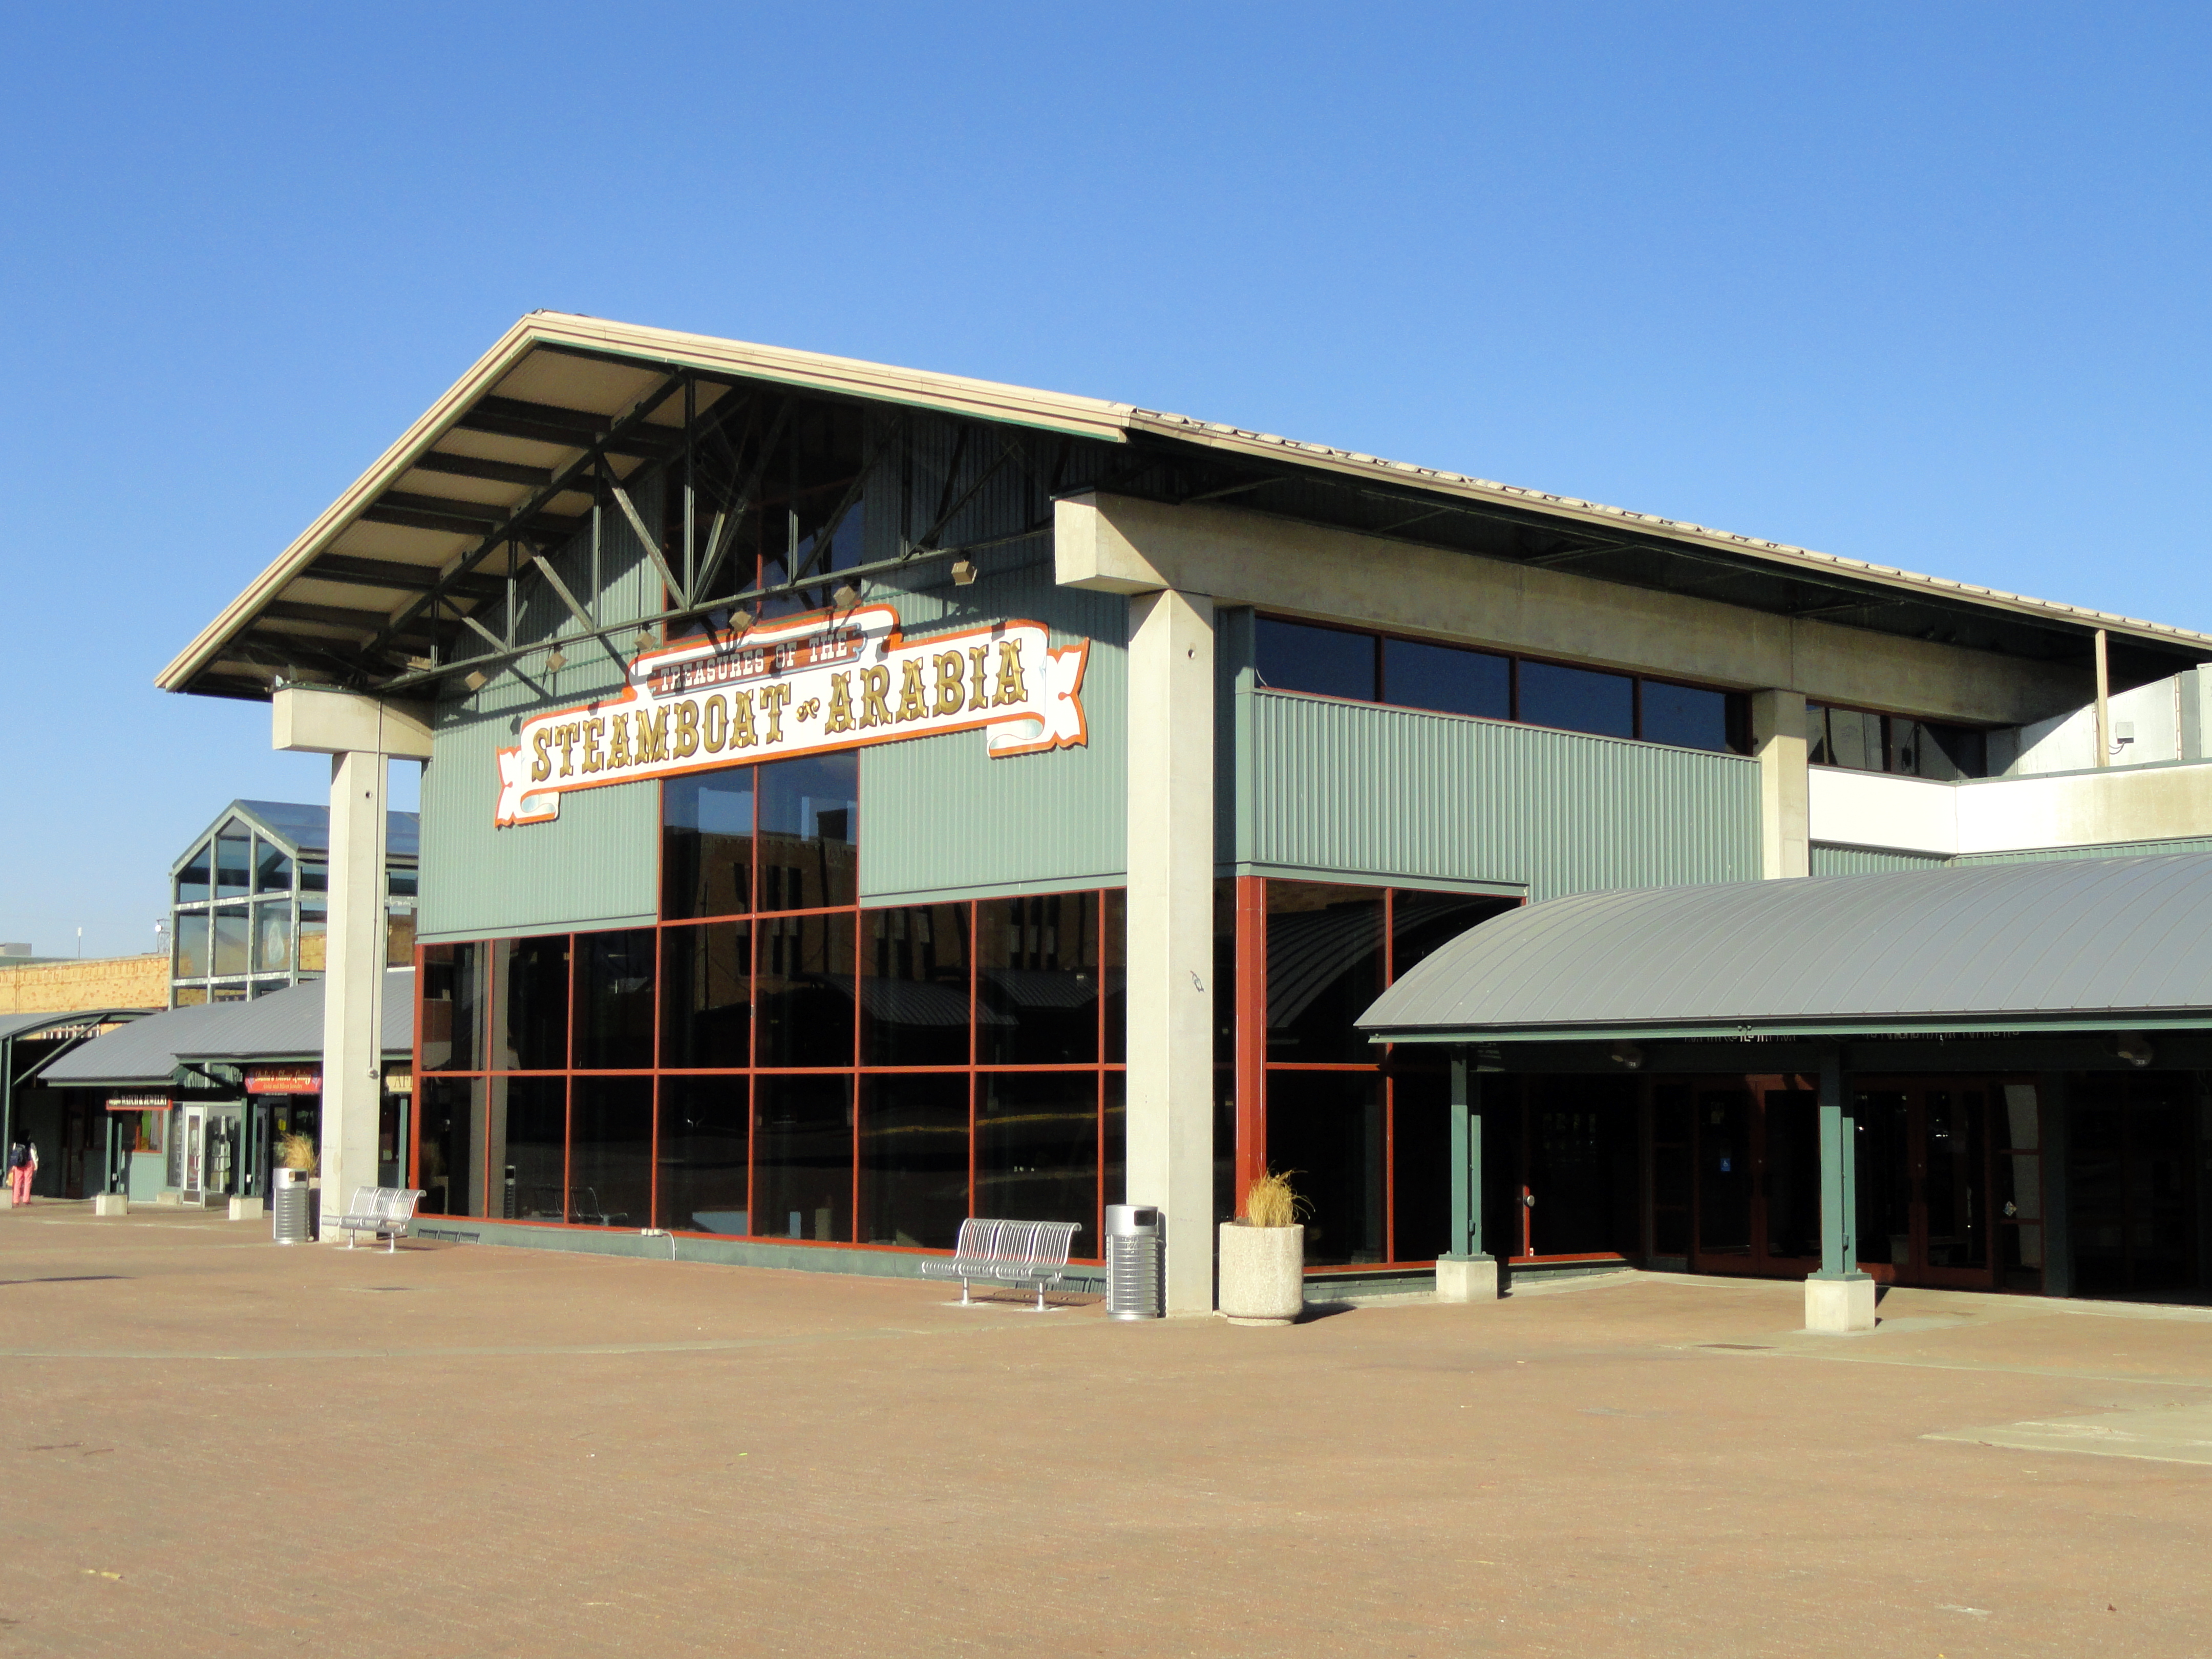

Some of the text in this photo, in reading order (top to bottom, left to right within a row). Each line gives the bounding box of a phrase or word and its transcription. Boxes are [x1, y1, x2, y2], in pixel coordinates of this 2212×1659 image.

[661, 631, 847, 691] TREASURES OF THE
[531, 638, 1028, 782] STEAMBOAT ARABIA
[121, 1094, 138, 1105] WATCH
[144, 1094, 167, 1105] JEWELRY
